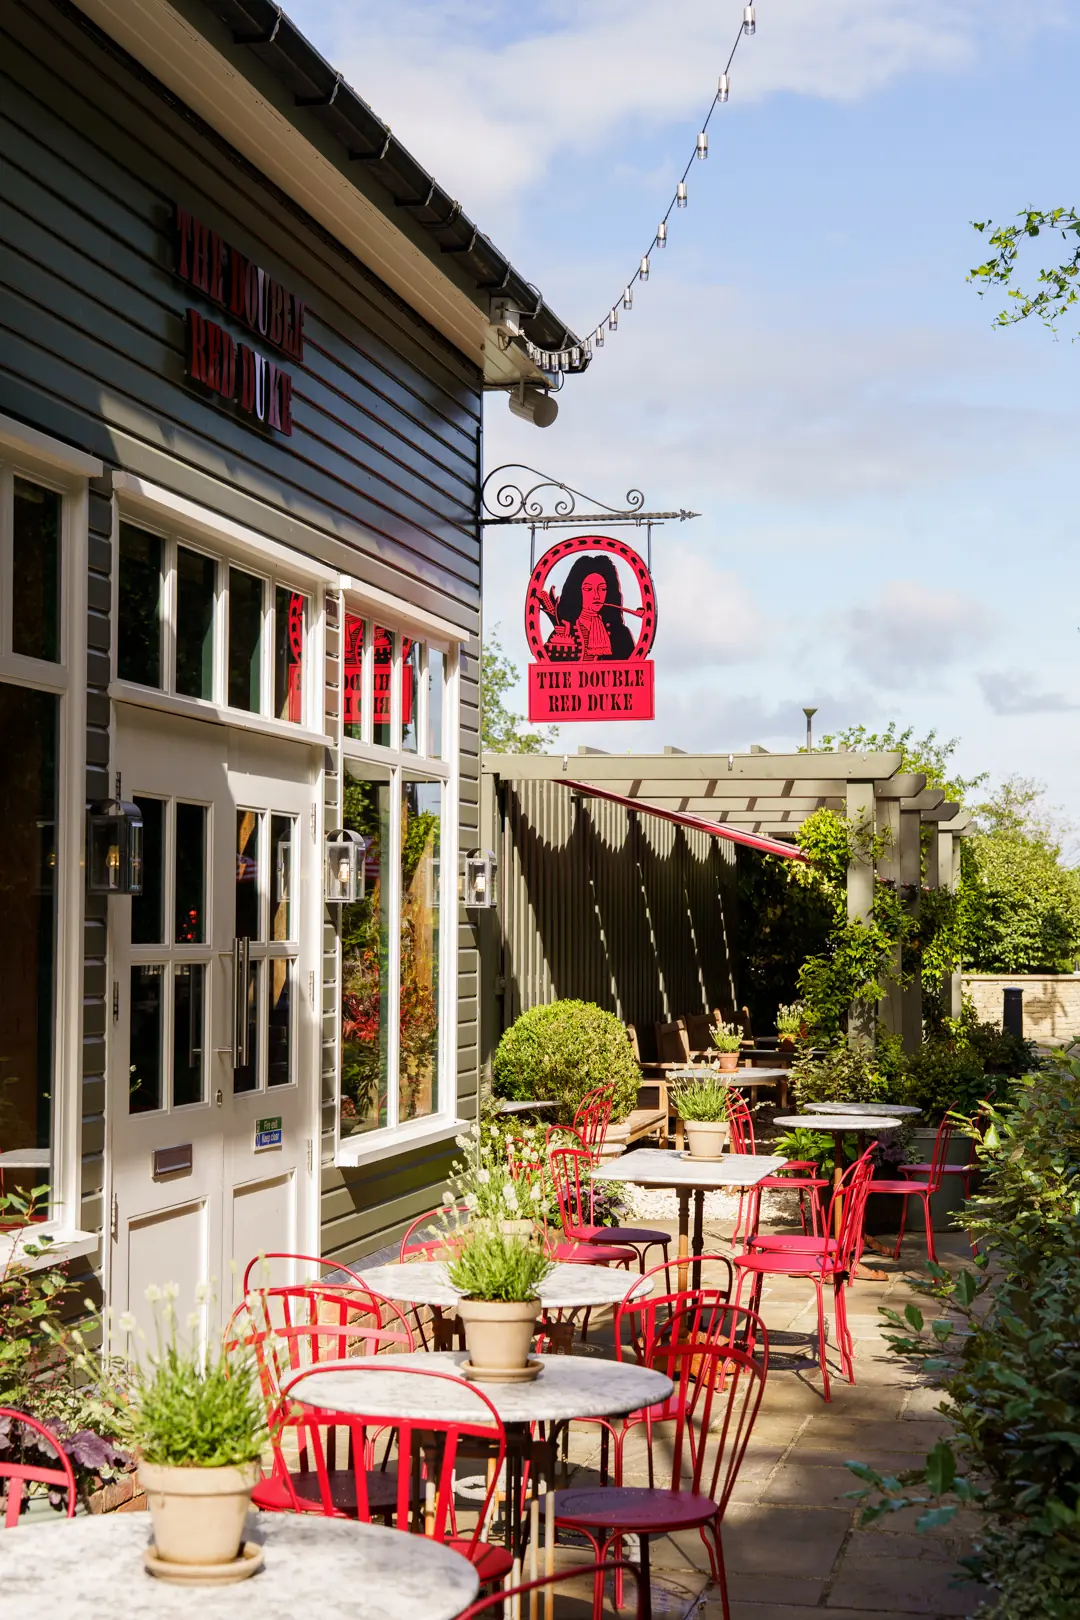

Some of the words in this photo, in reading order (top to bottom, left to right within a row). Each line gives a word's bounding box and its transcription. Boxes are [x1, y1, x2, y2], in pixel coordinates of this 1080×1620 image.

[177, 204, 226, 307] THE
[230, 248, 305, 361] DOUBLE
[187, 308, 236, 399] RED
[239, 343, 292, 436] DUKE
[537, 671, 571, 689] THE
[579, 670, 645, 687] DOUBLE
[549, 695, 581, 712] RED
[588, 694, 633, 711] DUKE
